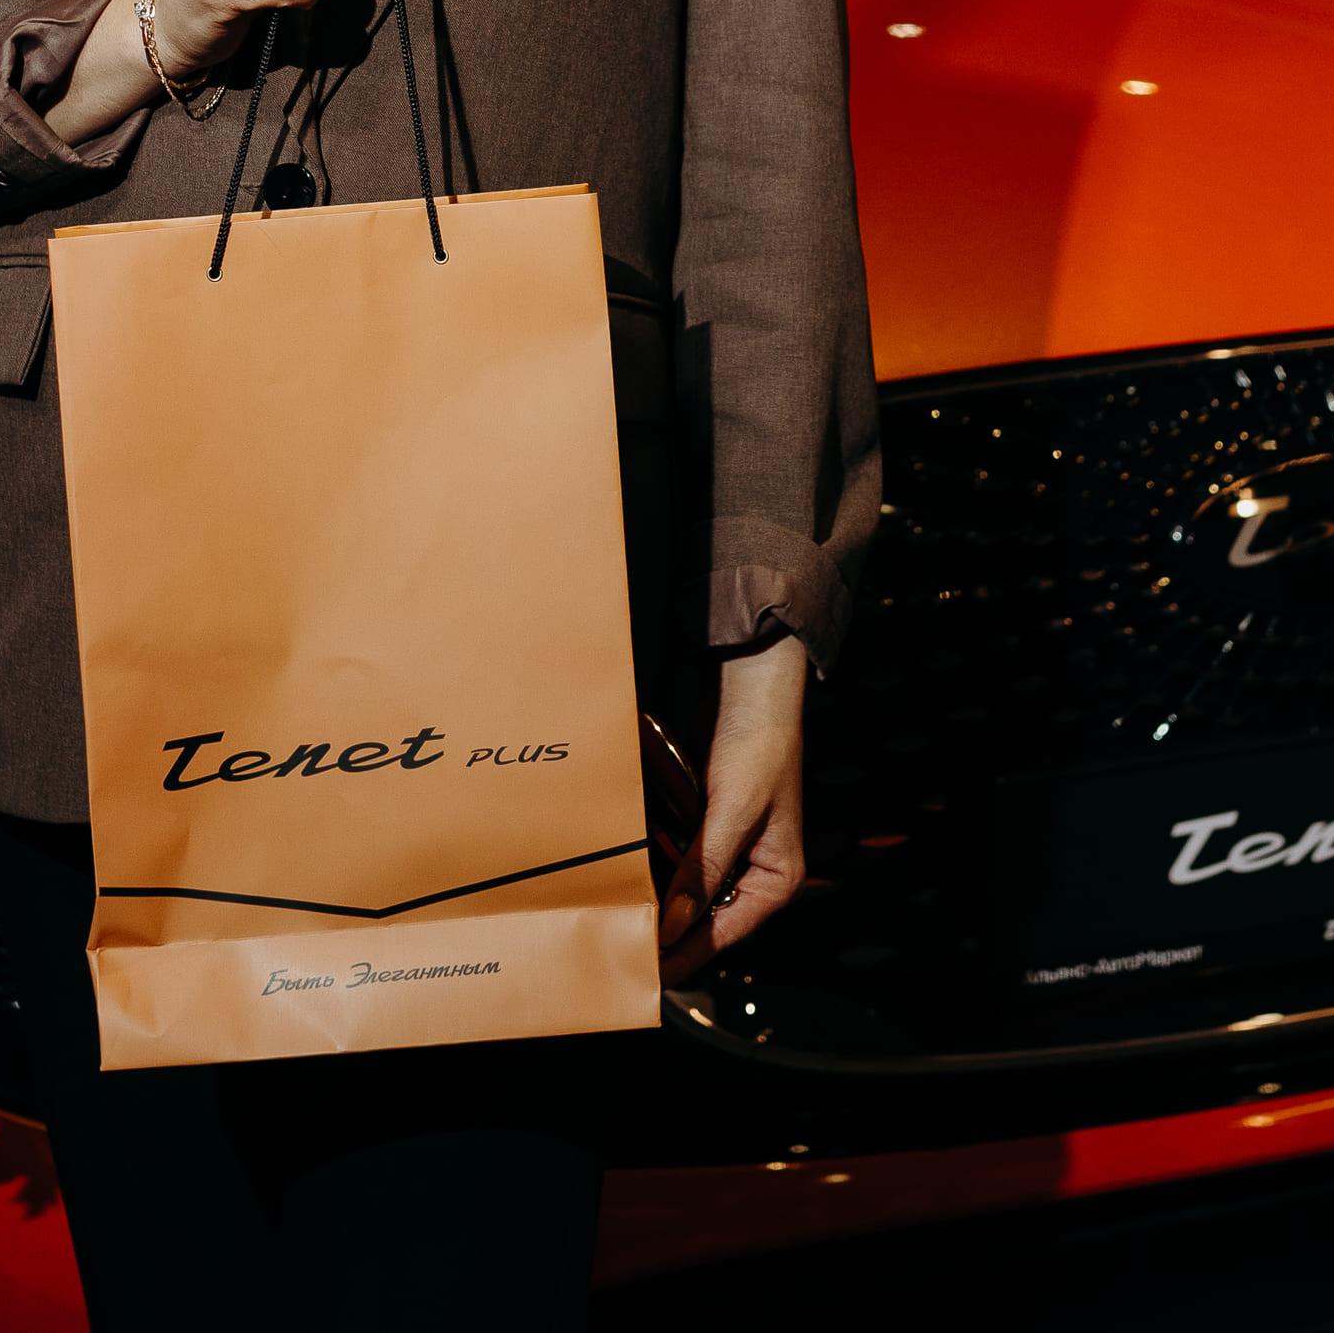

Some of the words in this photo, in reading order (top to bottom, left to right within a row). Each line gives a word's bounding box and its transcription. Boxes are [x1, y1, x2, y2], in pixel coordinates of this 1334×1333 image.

[163, 727, 446, 791] Tenet
[466, 743, 570, 767] PLUS
[261, 969, 335, 996] Быть
[346, 961, 501, 989] Элегантным
